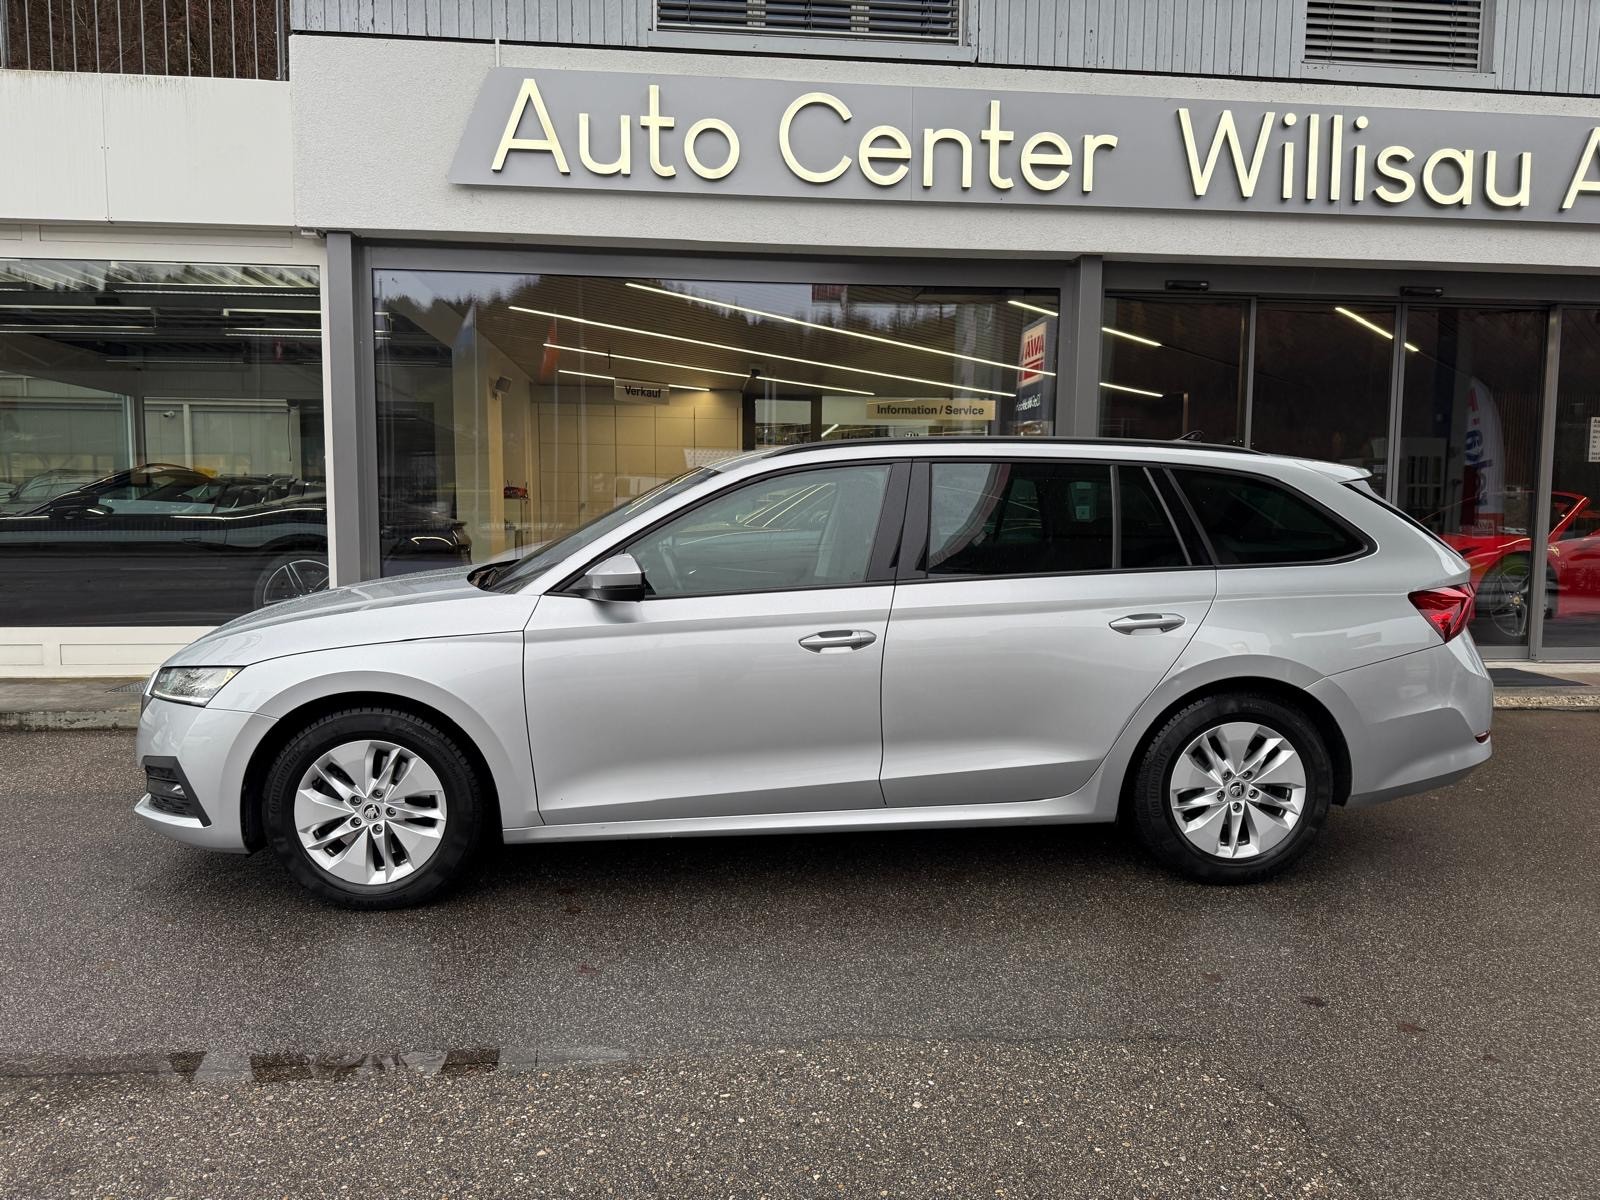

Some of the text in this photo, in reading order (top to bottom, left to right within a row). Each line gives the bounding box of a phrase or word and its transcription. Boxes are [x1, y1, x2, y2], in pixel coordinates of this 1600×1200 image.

[491, 78, 740, 180] Auto
[778, 92, 1118, 193] Center
[1176, 107, 1533, 208] Willisau
[624, 385, 662, 398] Verkauf
[877, 404, 938, 415] Information
[945, 405, 984, 415] Service
